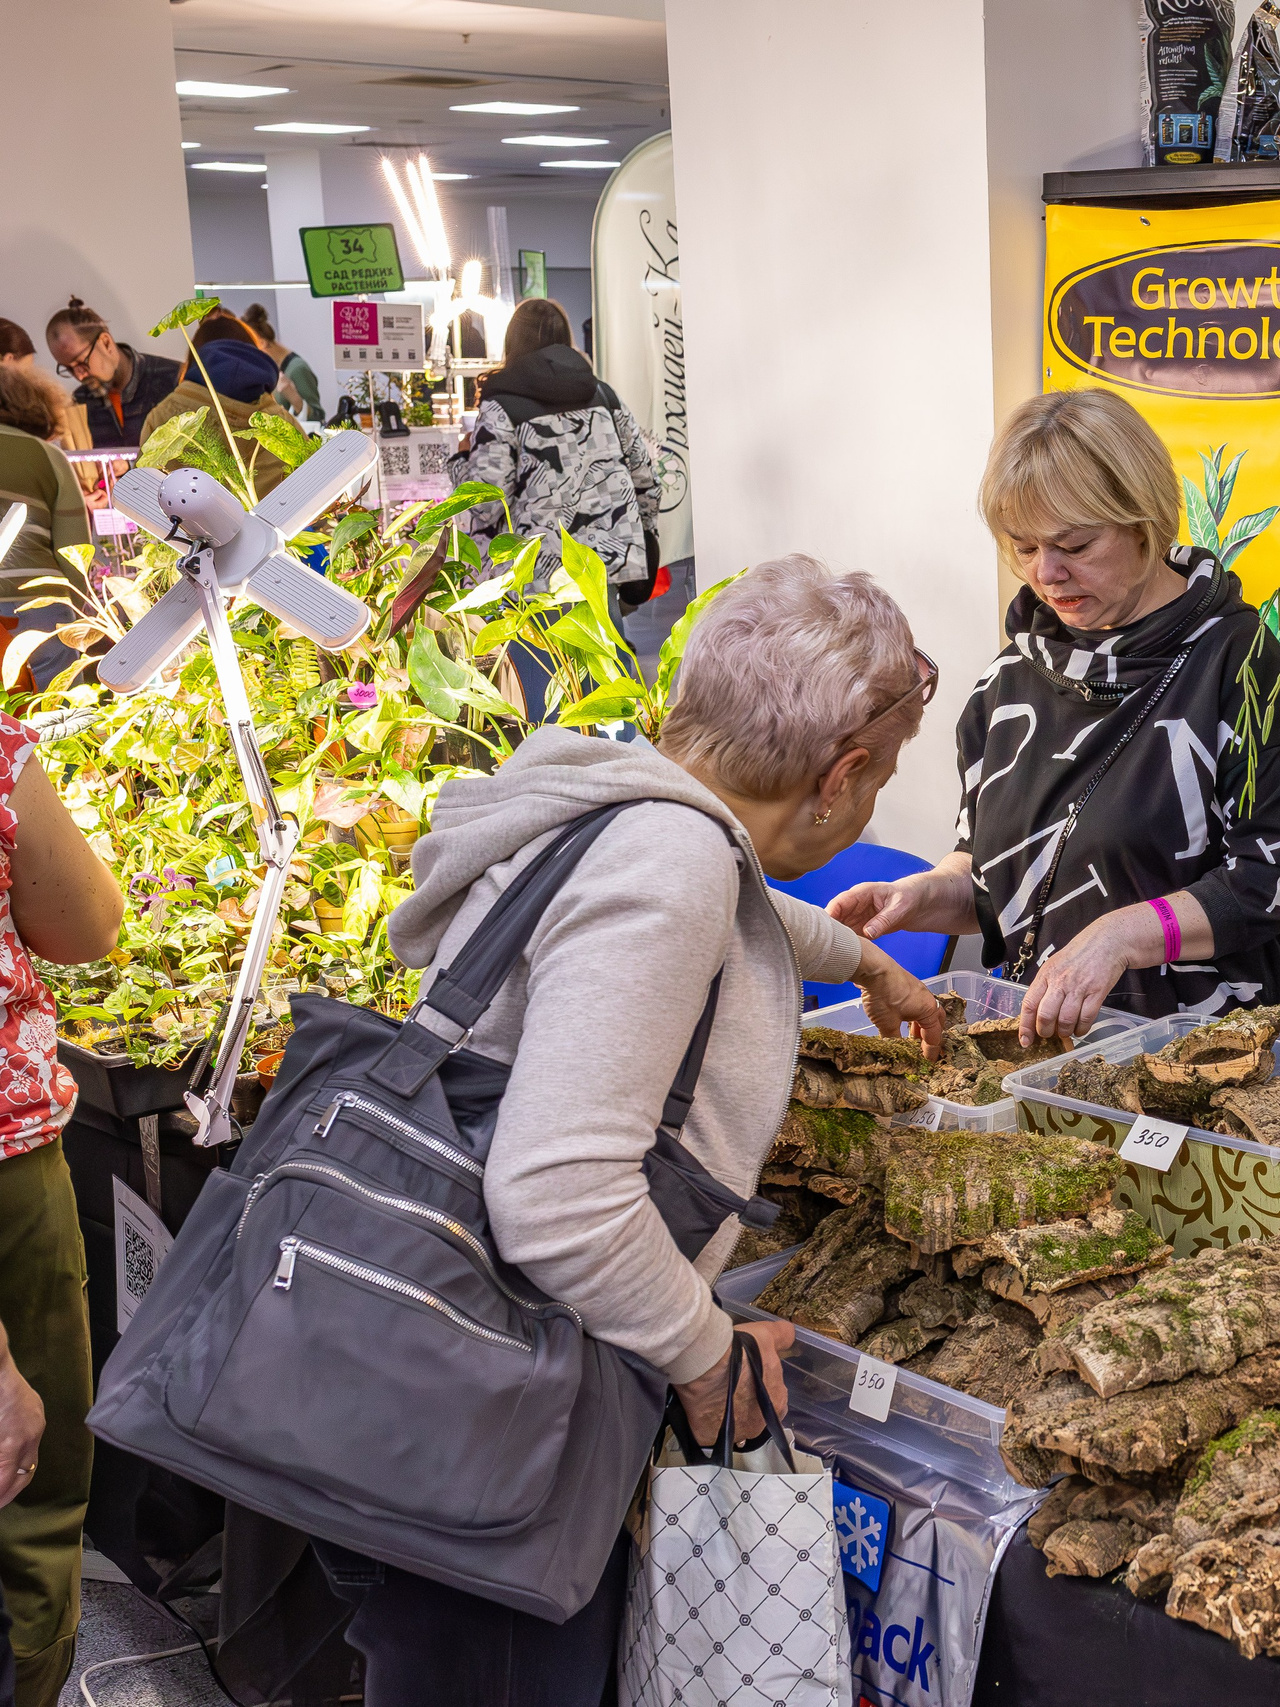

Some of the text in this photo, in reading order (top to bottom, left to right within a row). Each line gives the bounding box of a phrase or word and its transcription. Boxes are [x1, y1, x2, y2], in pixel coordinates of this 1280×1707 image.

[340, 238, 364, 254] 34
[324, 267, 394, 281] САД РЕДКИХ
[331, 278, 388, 291] РАСТЕНИЙ
[354, 689, 375, 698] 3000
[1133, 1129, 1170, 1148] 350
[858, 1370, 885, 1390] 350
